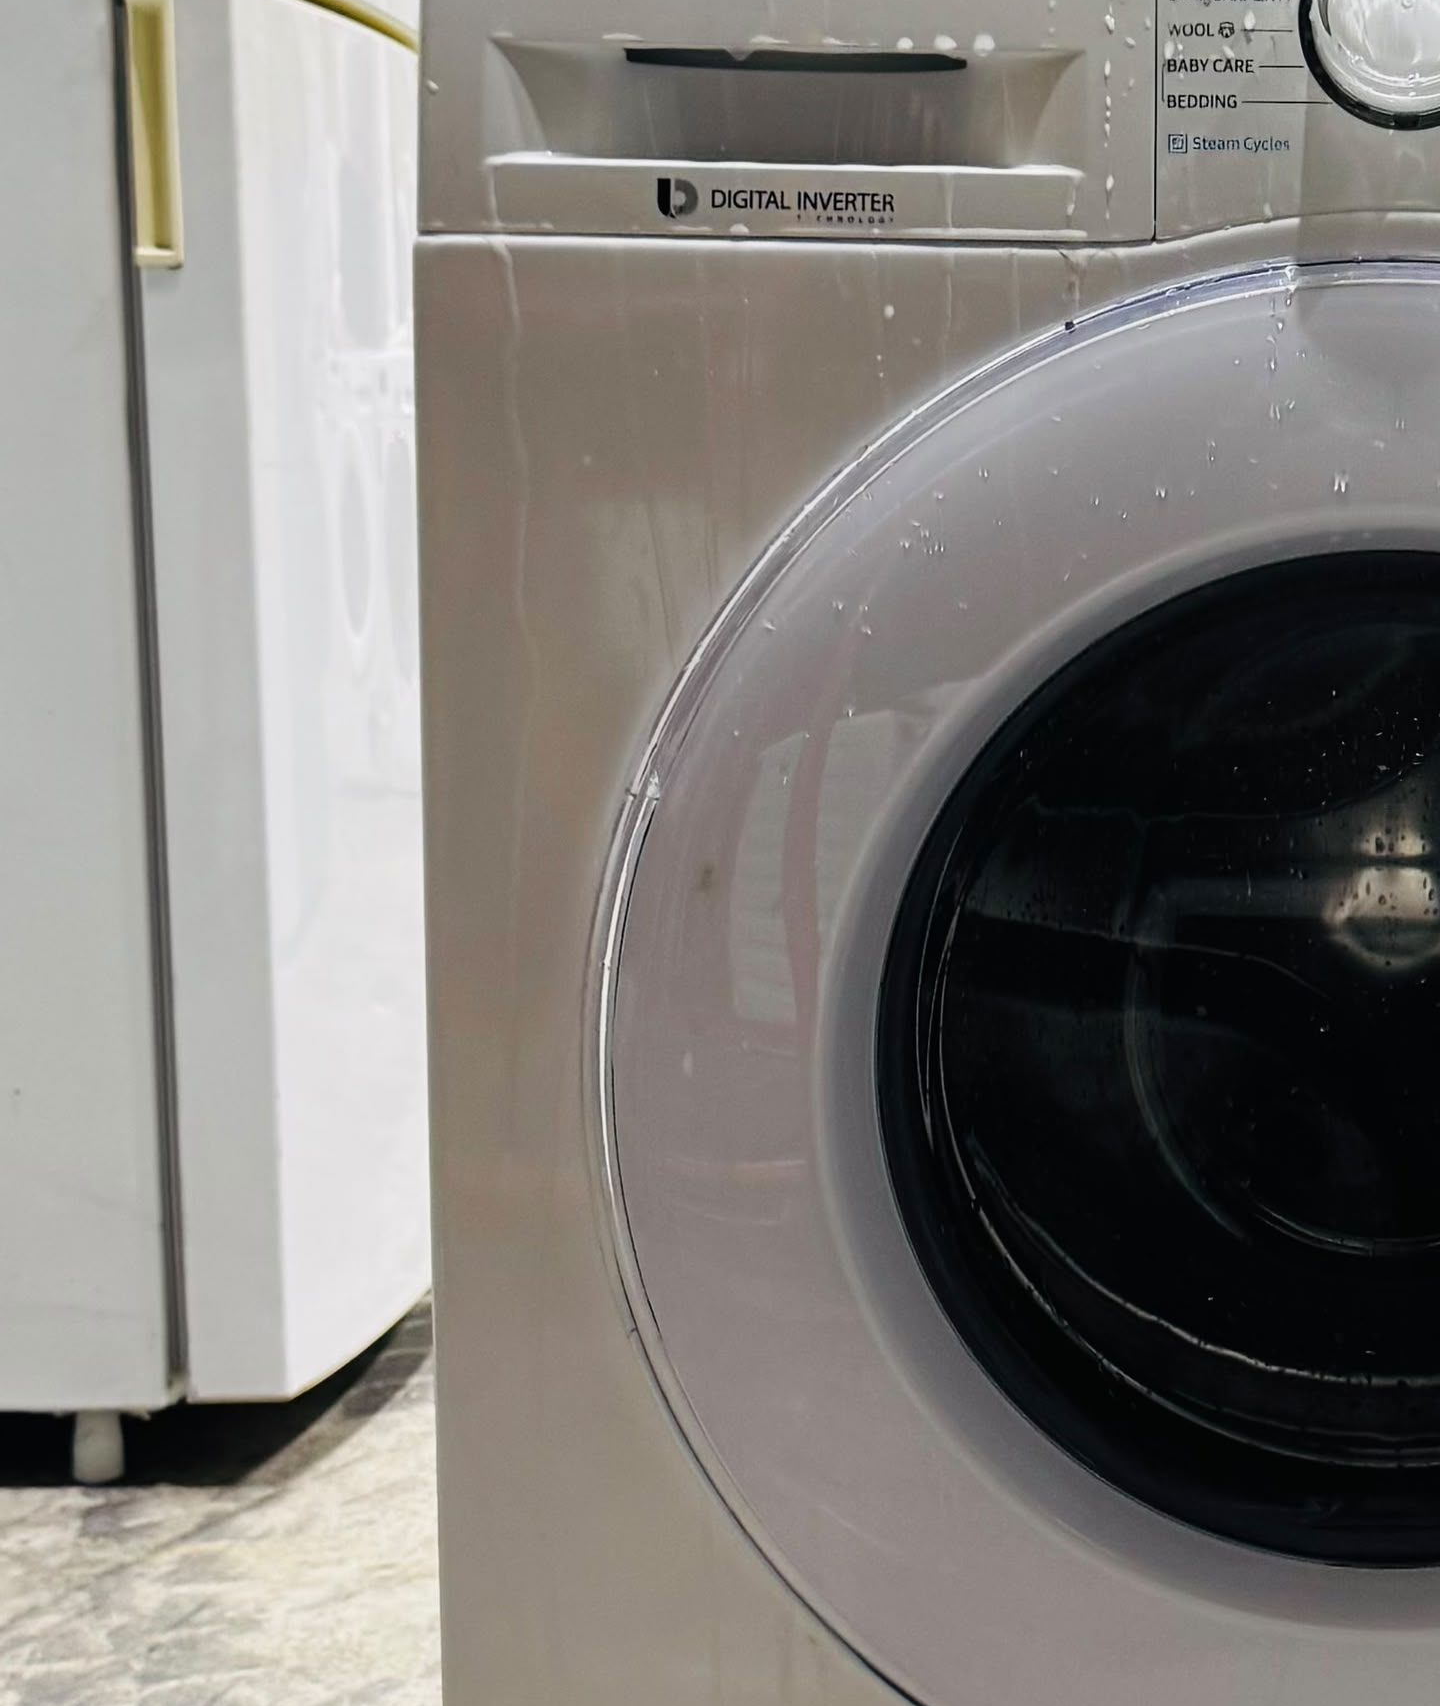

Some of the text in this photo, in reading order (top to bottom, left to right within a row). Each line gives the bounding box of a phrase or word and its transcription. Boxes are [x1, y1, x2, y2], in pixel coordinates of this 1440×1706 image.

[1168, 23, 1214, 37] WOOL
[1167, 59, 1254, 73] BABY CARE
[1167, 94, 1238, 109] BEDDING
[1192, 136, 1290, 153] Steam Cycles
[712, 190, 894, 212] DIGITAL INVERTER
